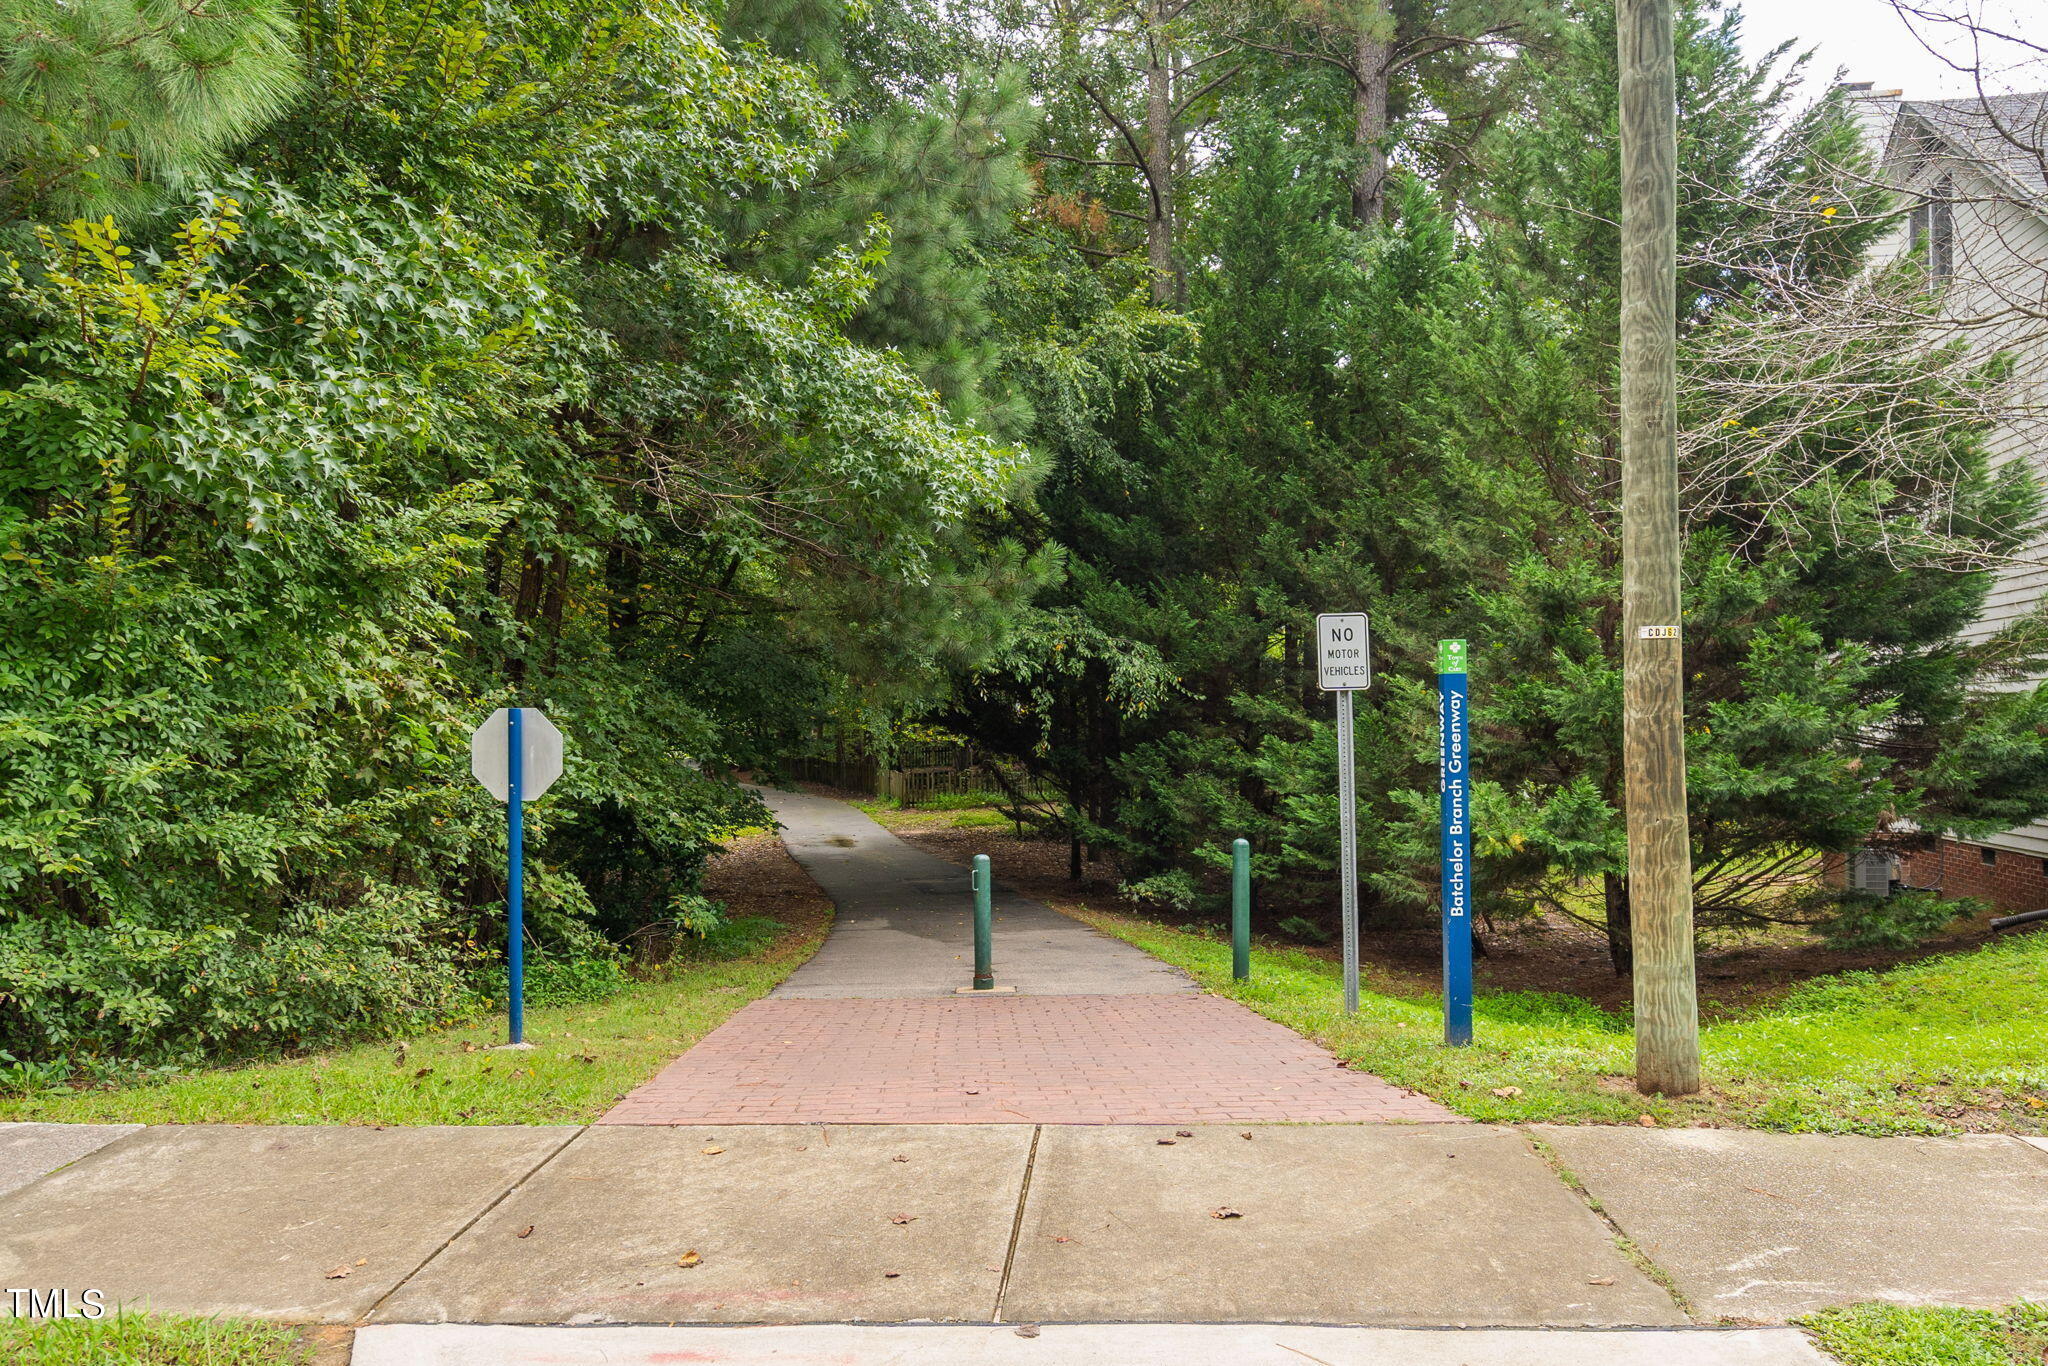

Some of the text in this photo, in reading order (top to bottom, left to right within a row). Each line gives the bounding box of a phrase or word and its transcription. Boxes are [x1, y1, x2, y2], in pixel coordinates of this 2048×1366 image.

[1331, 627, 1354, 642] NO
[1327, 648, 1360, 659] MOTOR
[1323, 665, 1366, 676] VEHICLES
[1448, 690, 1464, 917] Batchelor Branch Greenway
